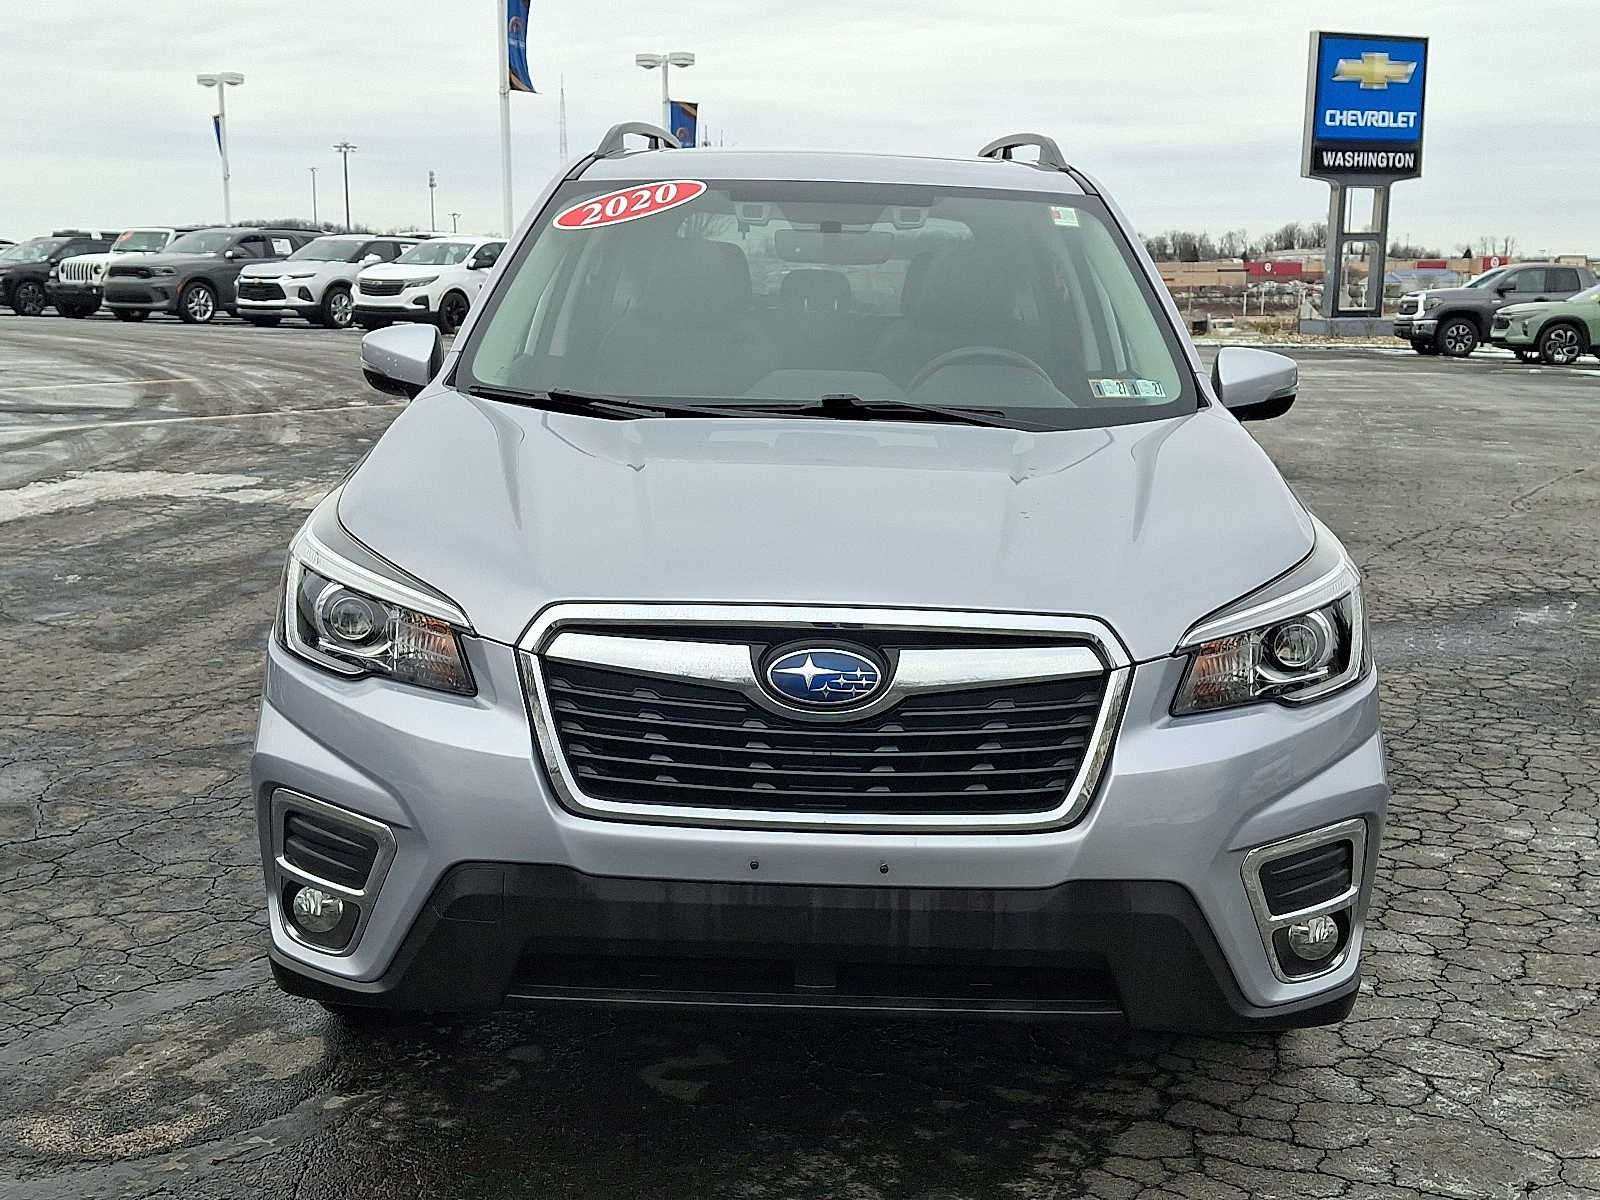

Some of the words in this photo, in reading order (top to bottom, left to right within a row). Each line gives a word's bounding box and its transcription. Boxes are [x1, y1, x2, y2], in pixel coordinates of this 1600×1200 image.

[1324, 109, 1417, 128] CHEVROLET
[1322, 151, 1415, 168] WASHINGTON
[580, 183, 678, 226] 2020
